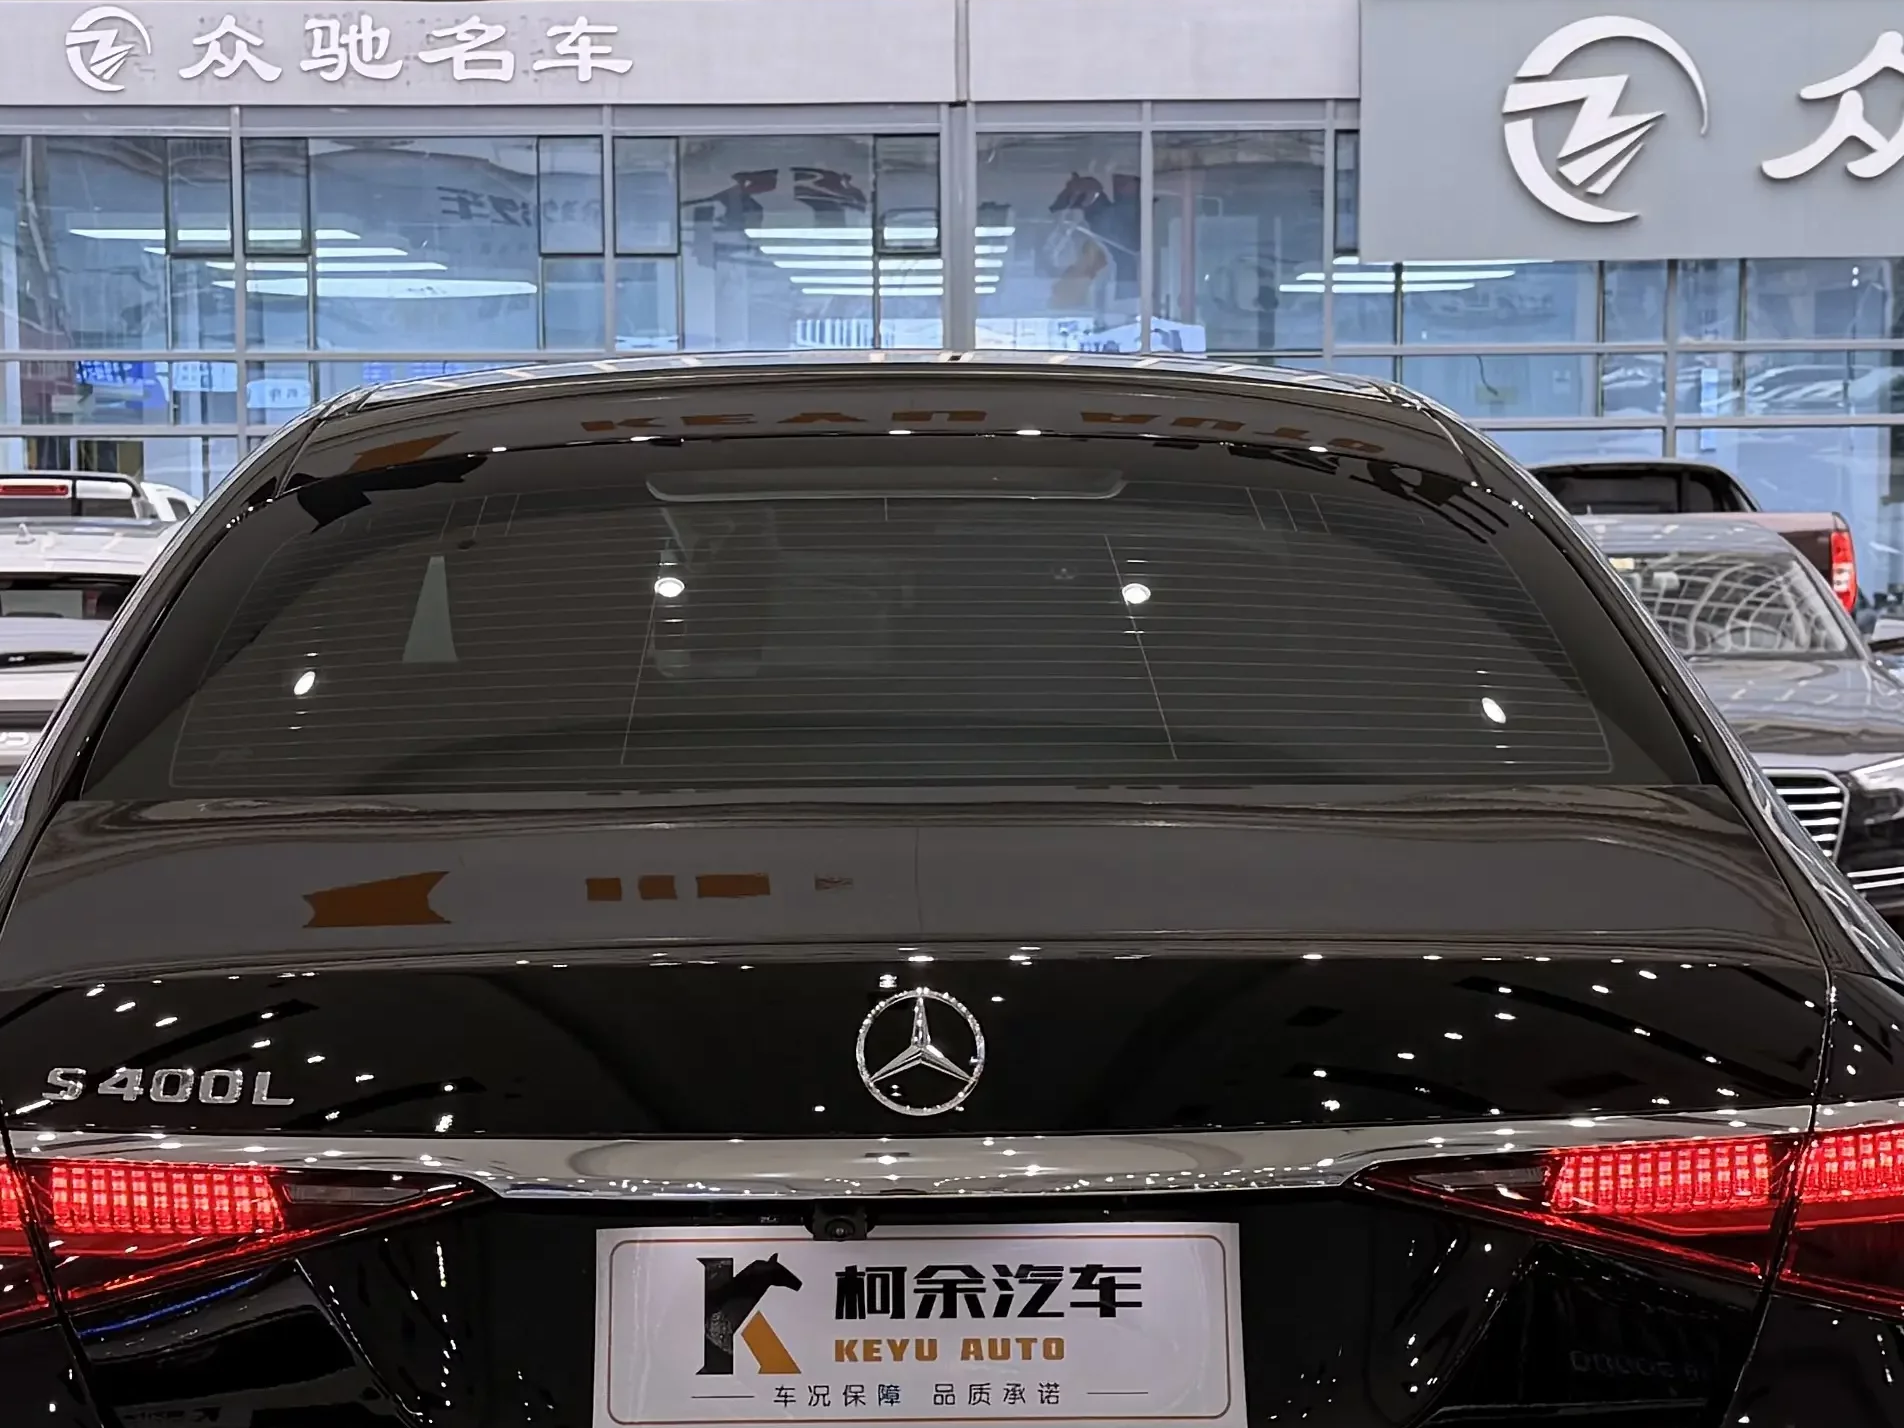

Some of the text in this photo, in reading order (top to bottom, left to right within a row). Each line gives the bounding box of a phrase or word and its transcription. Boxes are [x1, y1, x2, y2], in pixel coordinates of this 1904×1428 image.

[178, 13, 634, 83] 众驰名车
[834, 1262, 1144, 1321] 柯余汽车
[833, 1335, 1067, 1365] KEYU AUTO
[772, 1380, 1063, 1409] 车况保障 品质承诺
